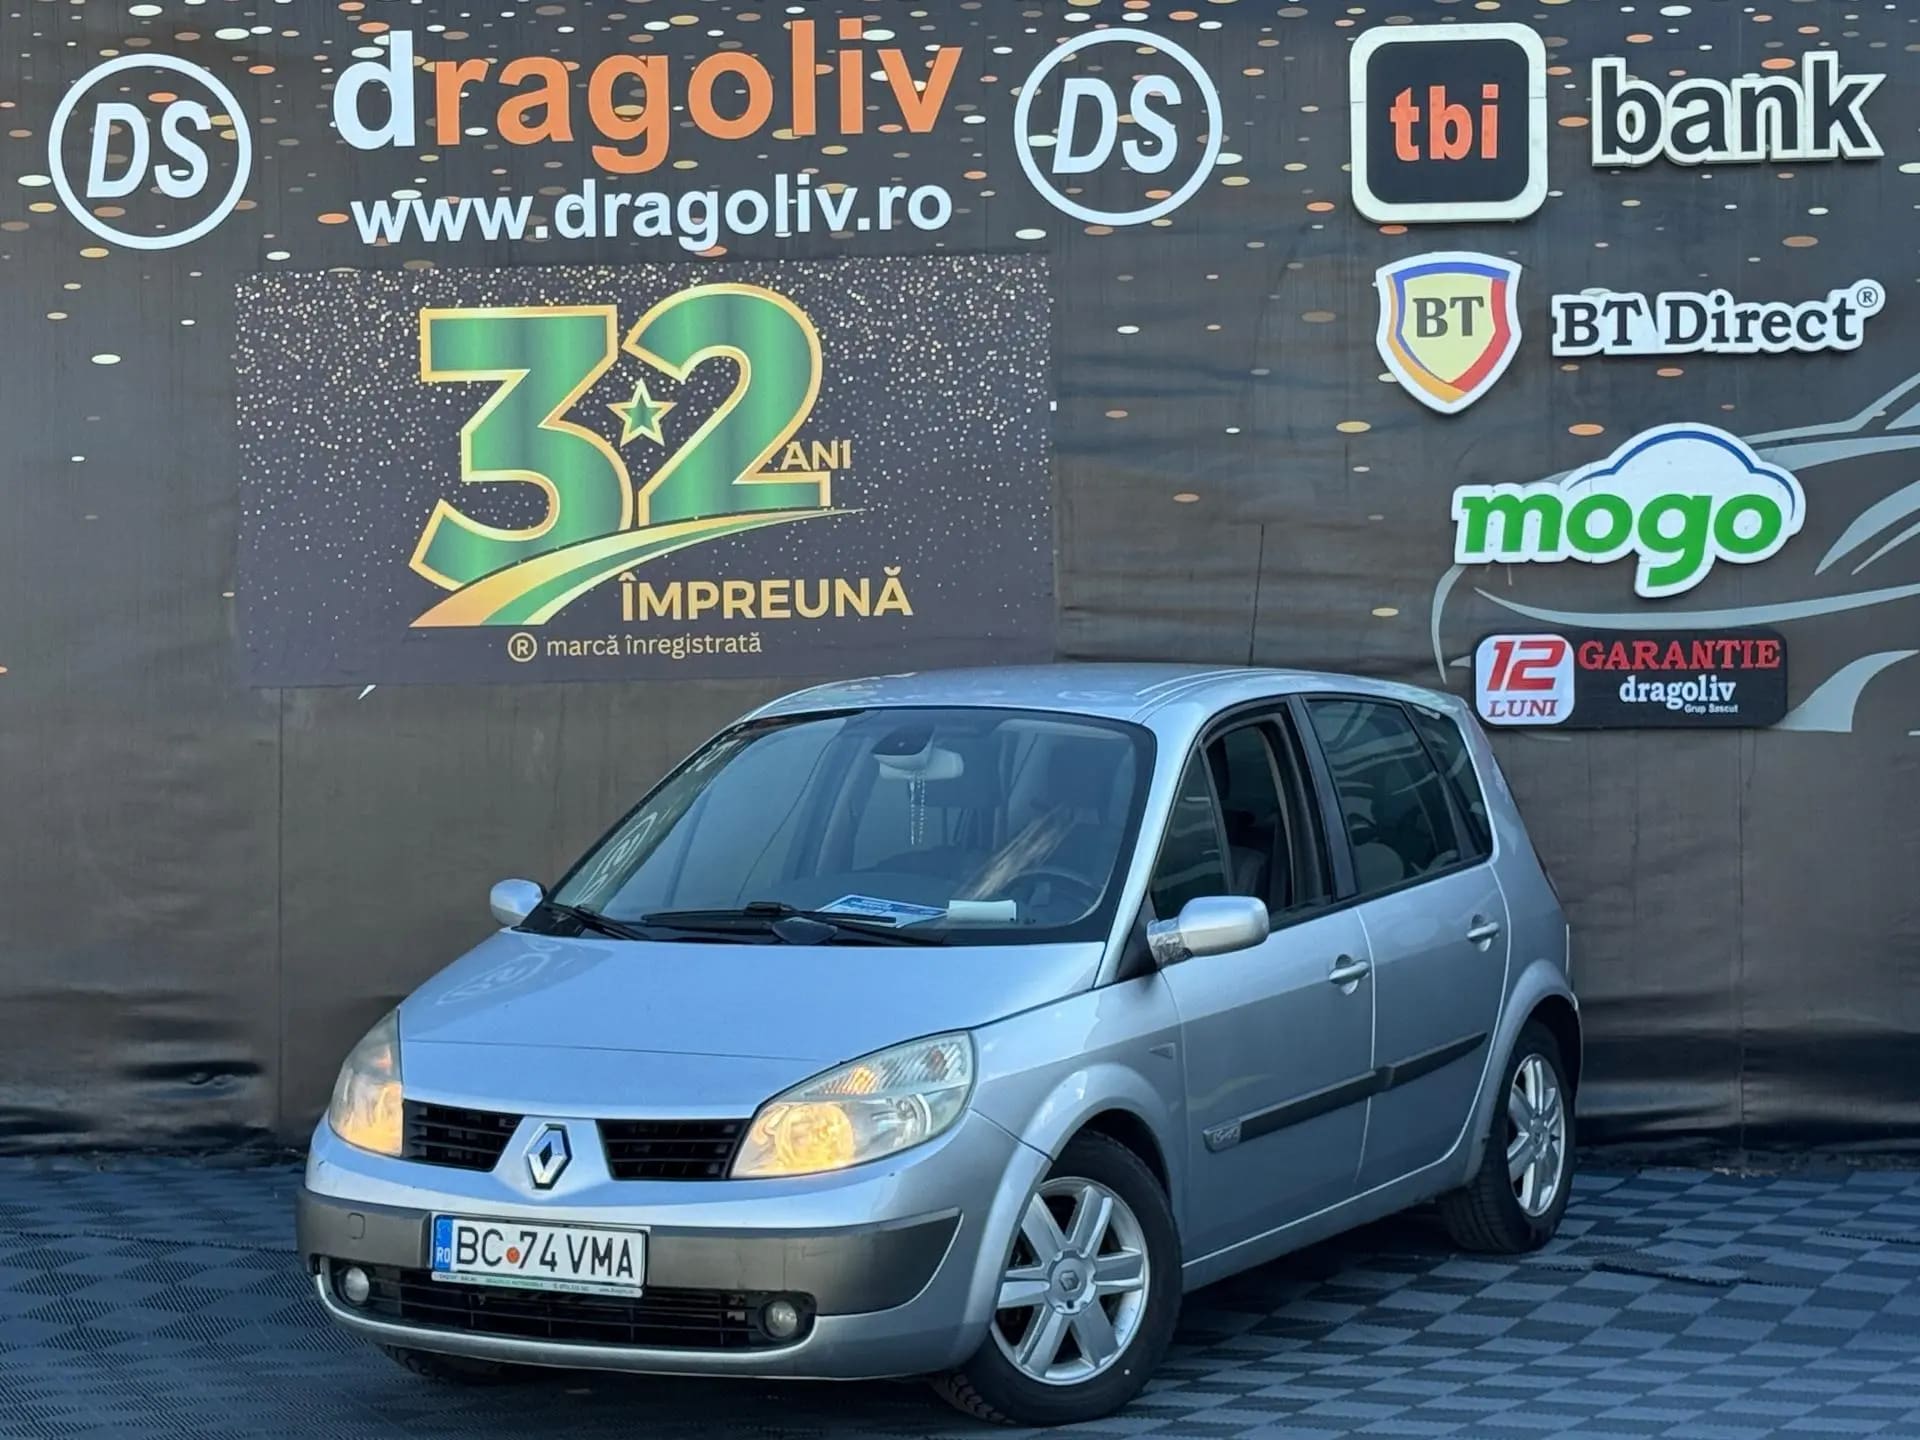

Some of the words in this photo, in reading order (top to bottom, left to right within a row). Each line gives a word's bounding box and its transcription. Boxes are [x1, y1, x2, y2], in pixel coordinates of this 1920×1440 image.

[333, 18, 962, 174] dragoliv
[1390, 84, 1499, 161] tbi
[1593, 52, 1885, 165] bank
[87, 101, 212, 198] DS
[1052, 75, 1181, 174] DS
[350, 173, 952, 252] www.dragoliv.ro
[1412, 295, 1484, 338] BT
[1560, 299, 1642, 347] BT
[408, 282, 834, 591] 32
[780, 440, 852, 472] ANI
[1461, 493, 1783, 588] mogo
[620, 566, 913, 622] ÎMPREUNĂ
[546, 634, 620, 657] marcă
[624, 632, 763, 660] înregistrată
[1486, 640, 1567, 692] 12
[1577, 639, 1781, 671] GARANTIE
[1487, 699, 1558, 718] LUNI
[1619, 674, 1737, 710] dragoliv
[1684, 703, 1706, 715] Grup
[456, 1226, 504, 1268] BC
[517, 1230, 558, 1273] 74
[566, 1233, 634, 1279] VMA
